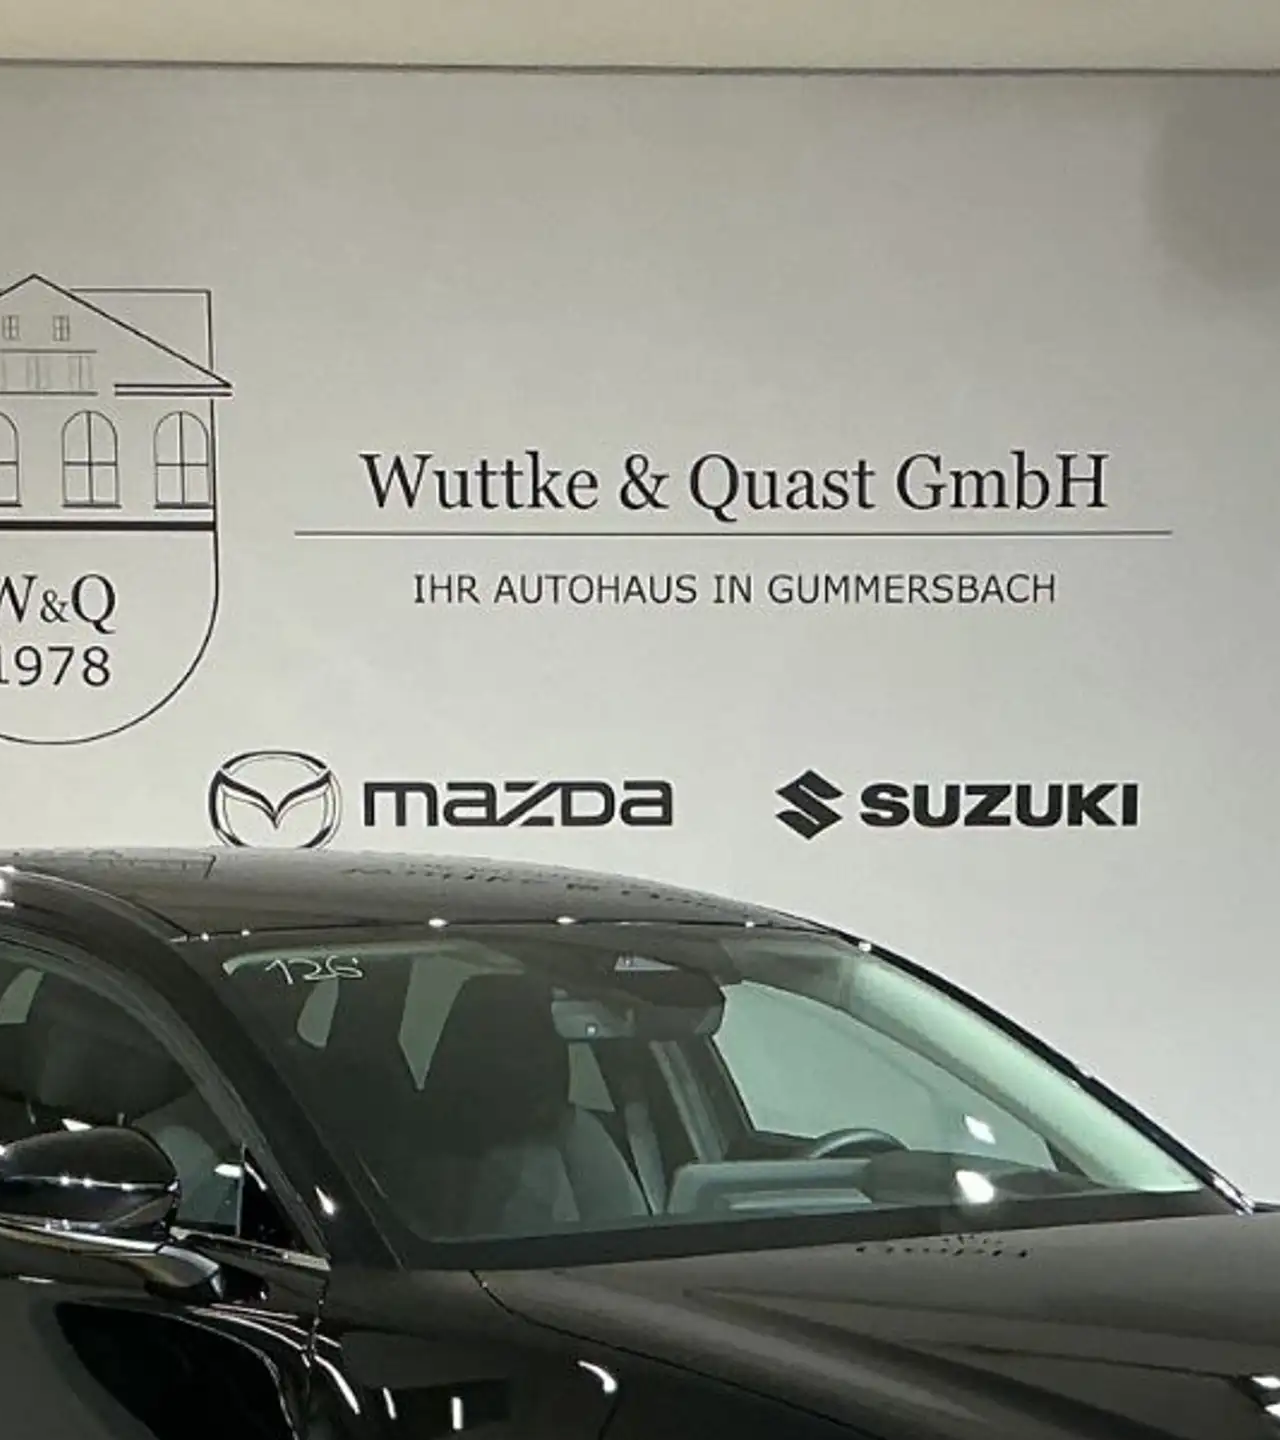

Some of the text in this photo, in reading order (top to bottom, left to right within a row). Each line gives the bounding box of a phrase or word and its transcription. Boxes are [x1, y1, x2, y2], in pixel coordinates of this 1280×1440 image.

[359, 449, 1110, 523] Wuttke & Quast GmbH
[413, 573, 1056, 604] IHR AUTOHAUS IN GUMMERSBACH
[860, 782, 1138, 828] SUZUKI
